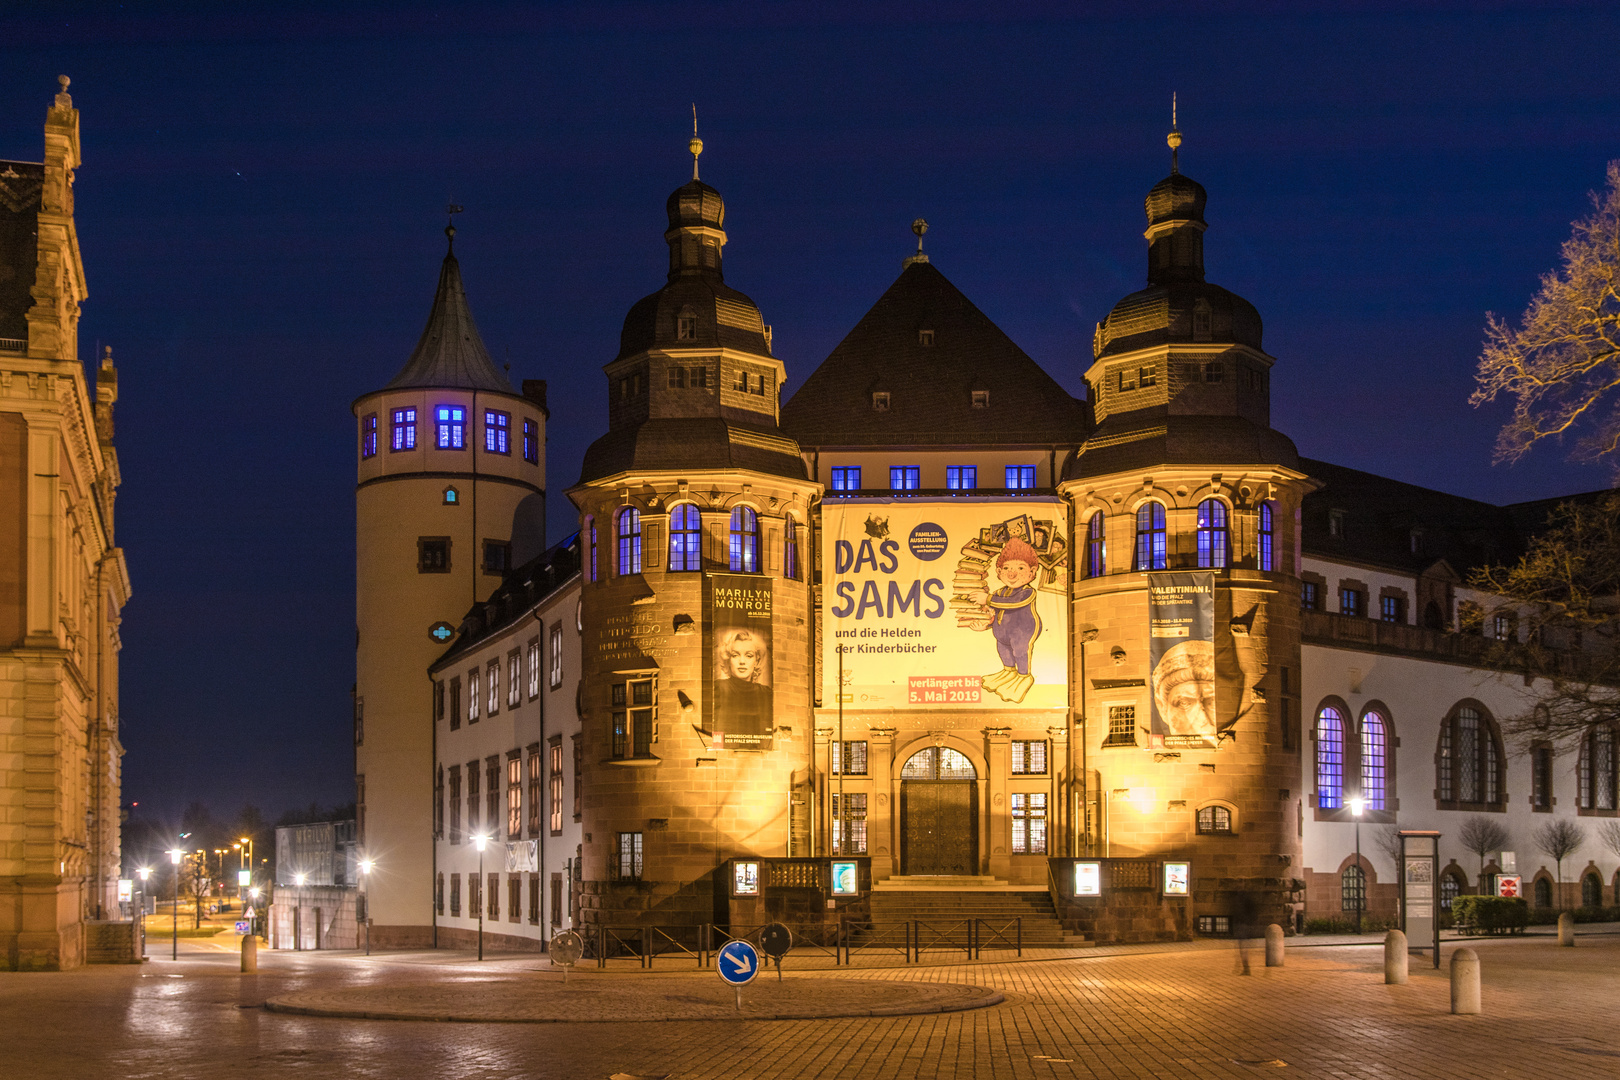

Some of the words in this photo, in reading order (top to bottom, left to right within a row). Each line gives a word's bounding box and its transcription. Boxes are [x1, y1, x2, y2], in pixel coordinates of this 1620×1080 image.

[835, 539, 900, 575] DAS
[715, 588, 771, 599] MARILYN
[1151, 585, 1204, 595] VALENTINIAN
[1205, 585, 1211, 594] I.
[715, 599, 771, 610] MONROE
[831, 578, 945, 620] SAMS
[835, 628, 857, 638] und
[860, 628, 878, 638] die
[881, 628, 922, 638] Helden
[835, 643, 854, 653] der
[857, 643, 937, 653] Kinderbücher
[910, 678, 963, 690] verlängert
[965, 677, 980, 687] bis
[910, 691, 922, 702] 5.
[925, 690, 947, 702] Mai
[950, 691, 979, 702] 2019
